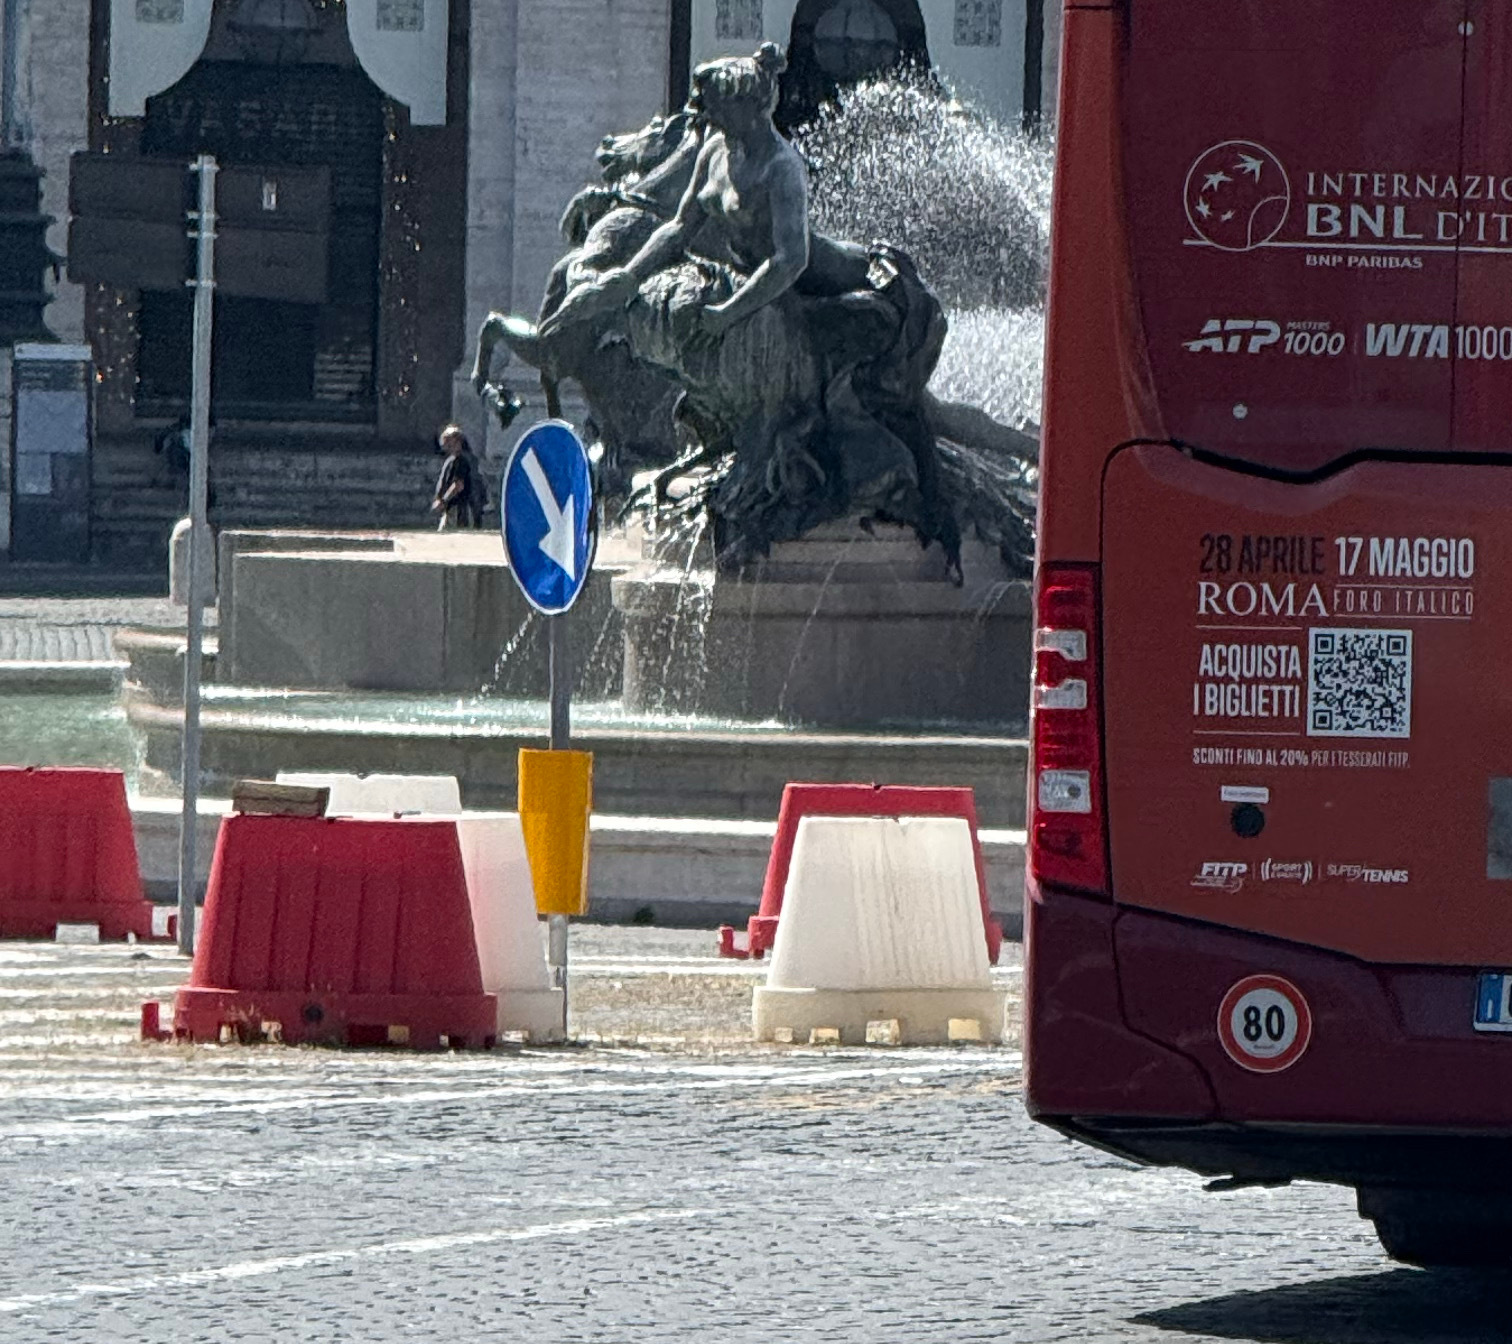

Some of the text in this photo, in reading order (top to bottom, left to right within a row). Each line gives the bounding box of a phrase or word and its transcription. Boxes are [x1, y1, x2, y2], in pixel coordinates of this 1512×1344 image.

[1306, 203, 1423, 240] BNL
[1305, 254, 1423, 269] BNP PARIBAS
[1181, 319, 1281, 354] ATP
[1283, 332, 1346, 356] 1000
[1199, 533, 1475, 579] 28 APRILE 17 MAGGIO
[1197, 581, 1474, 618] ROMA FORO ITALICO
[1199, 643, 1302, 682] ACQUISTA
[1193, 683, 1300, 718] I BIGLIETTI
[1192, 747, 1233, 765] SCONTI
[1236, 747, 1263, 765] FINO
[1265, 748, 1279, 766] AL
[1201, 862, 1248, 877] FITP
[1243, 1004, 1285, 1042] 80
